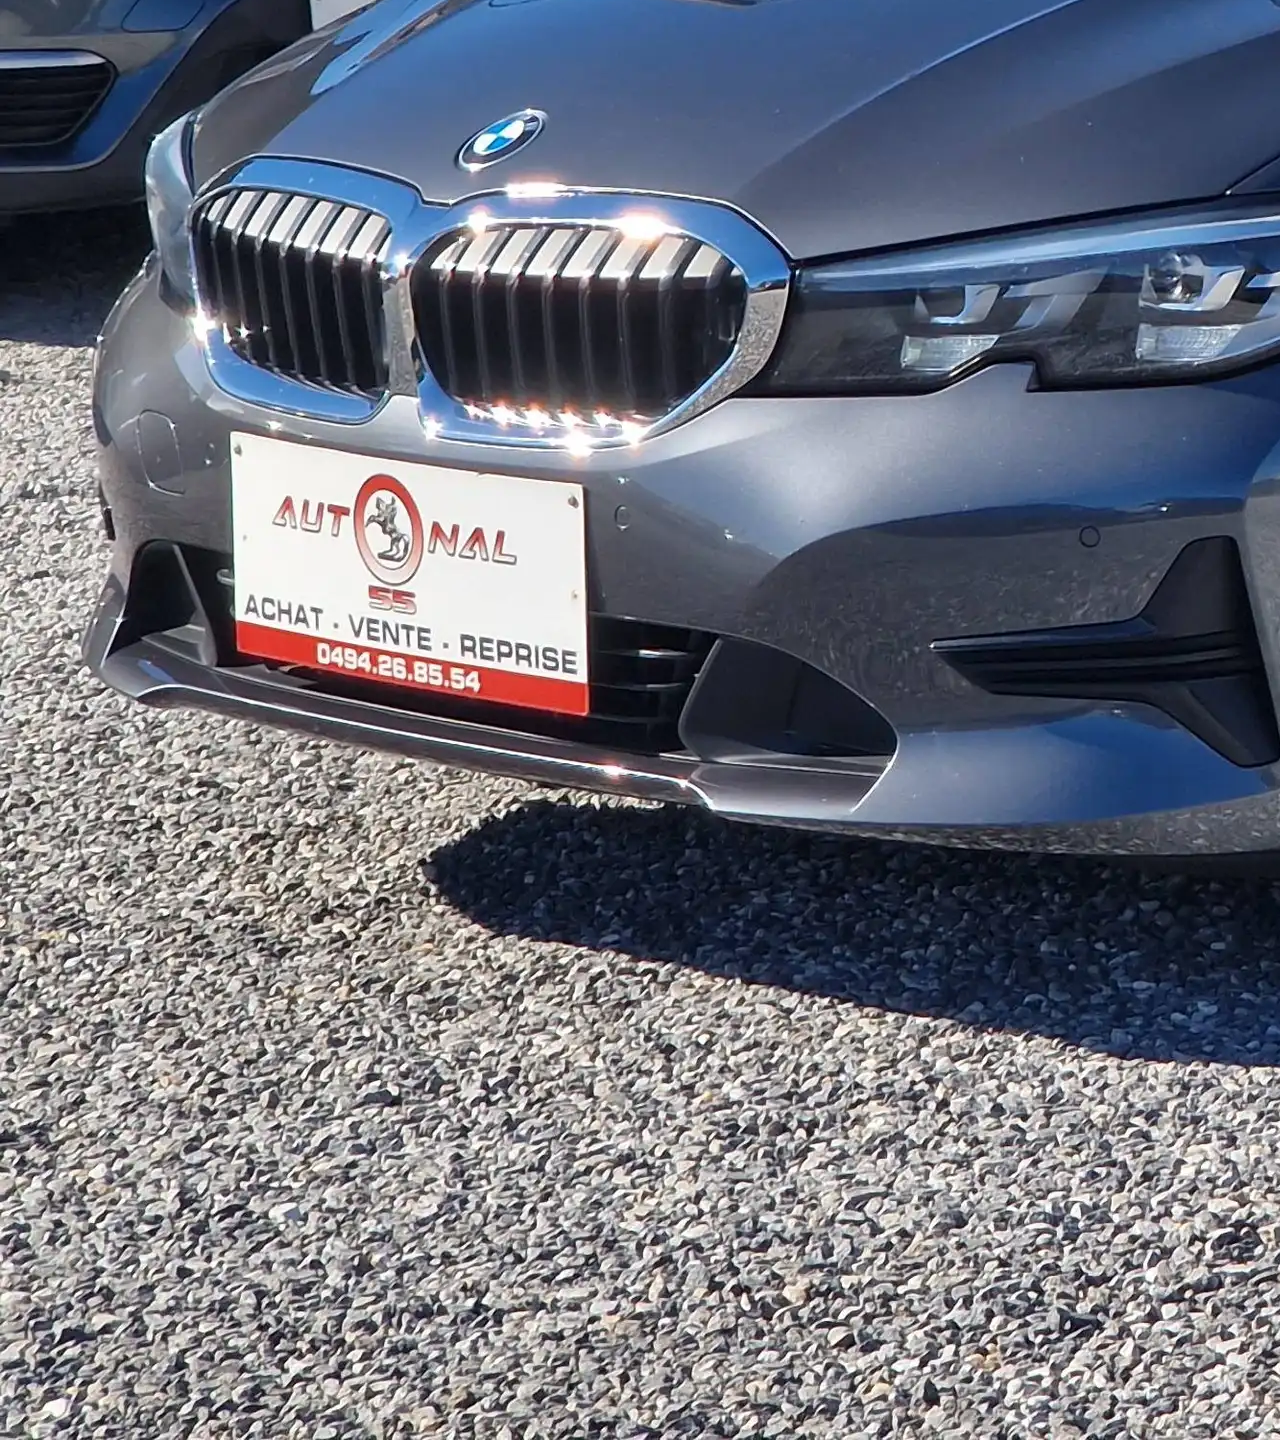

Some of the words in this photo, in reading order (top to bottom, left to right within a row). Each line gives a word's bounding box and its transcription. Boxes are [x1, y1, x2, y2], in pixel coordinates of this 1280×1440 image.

[272, 473, 518, 585] AUTONAL
[368, 586, 417, 614] 55
[244, 594, 324, 631] ACHAT
[349, 614, 432, 652] VENTE
[460, 633, 578, 676] REPRISE
[316, 642, 481, 694] 0494.26.85.54
